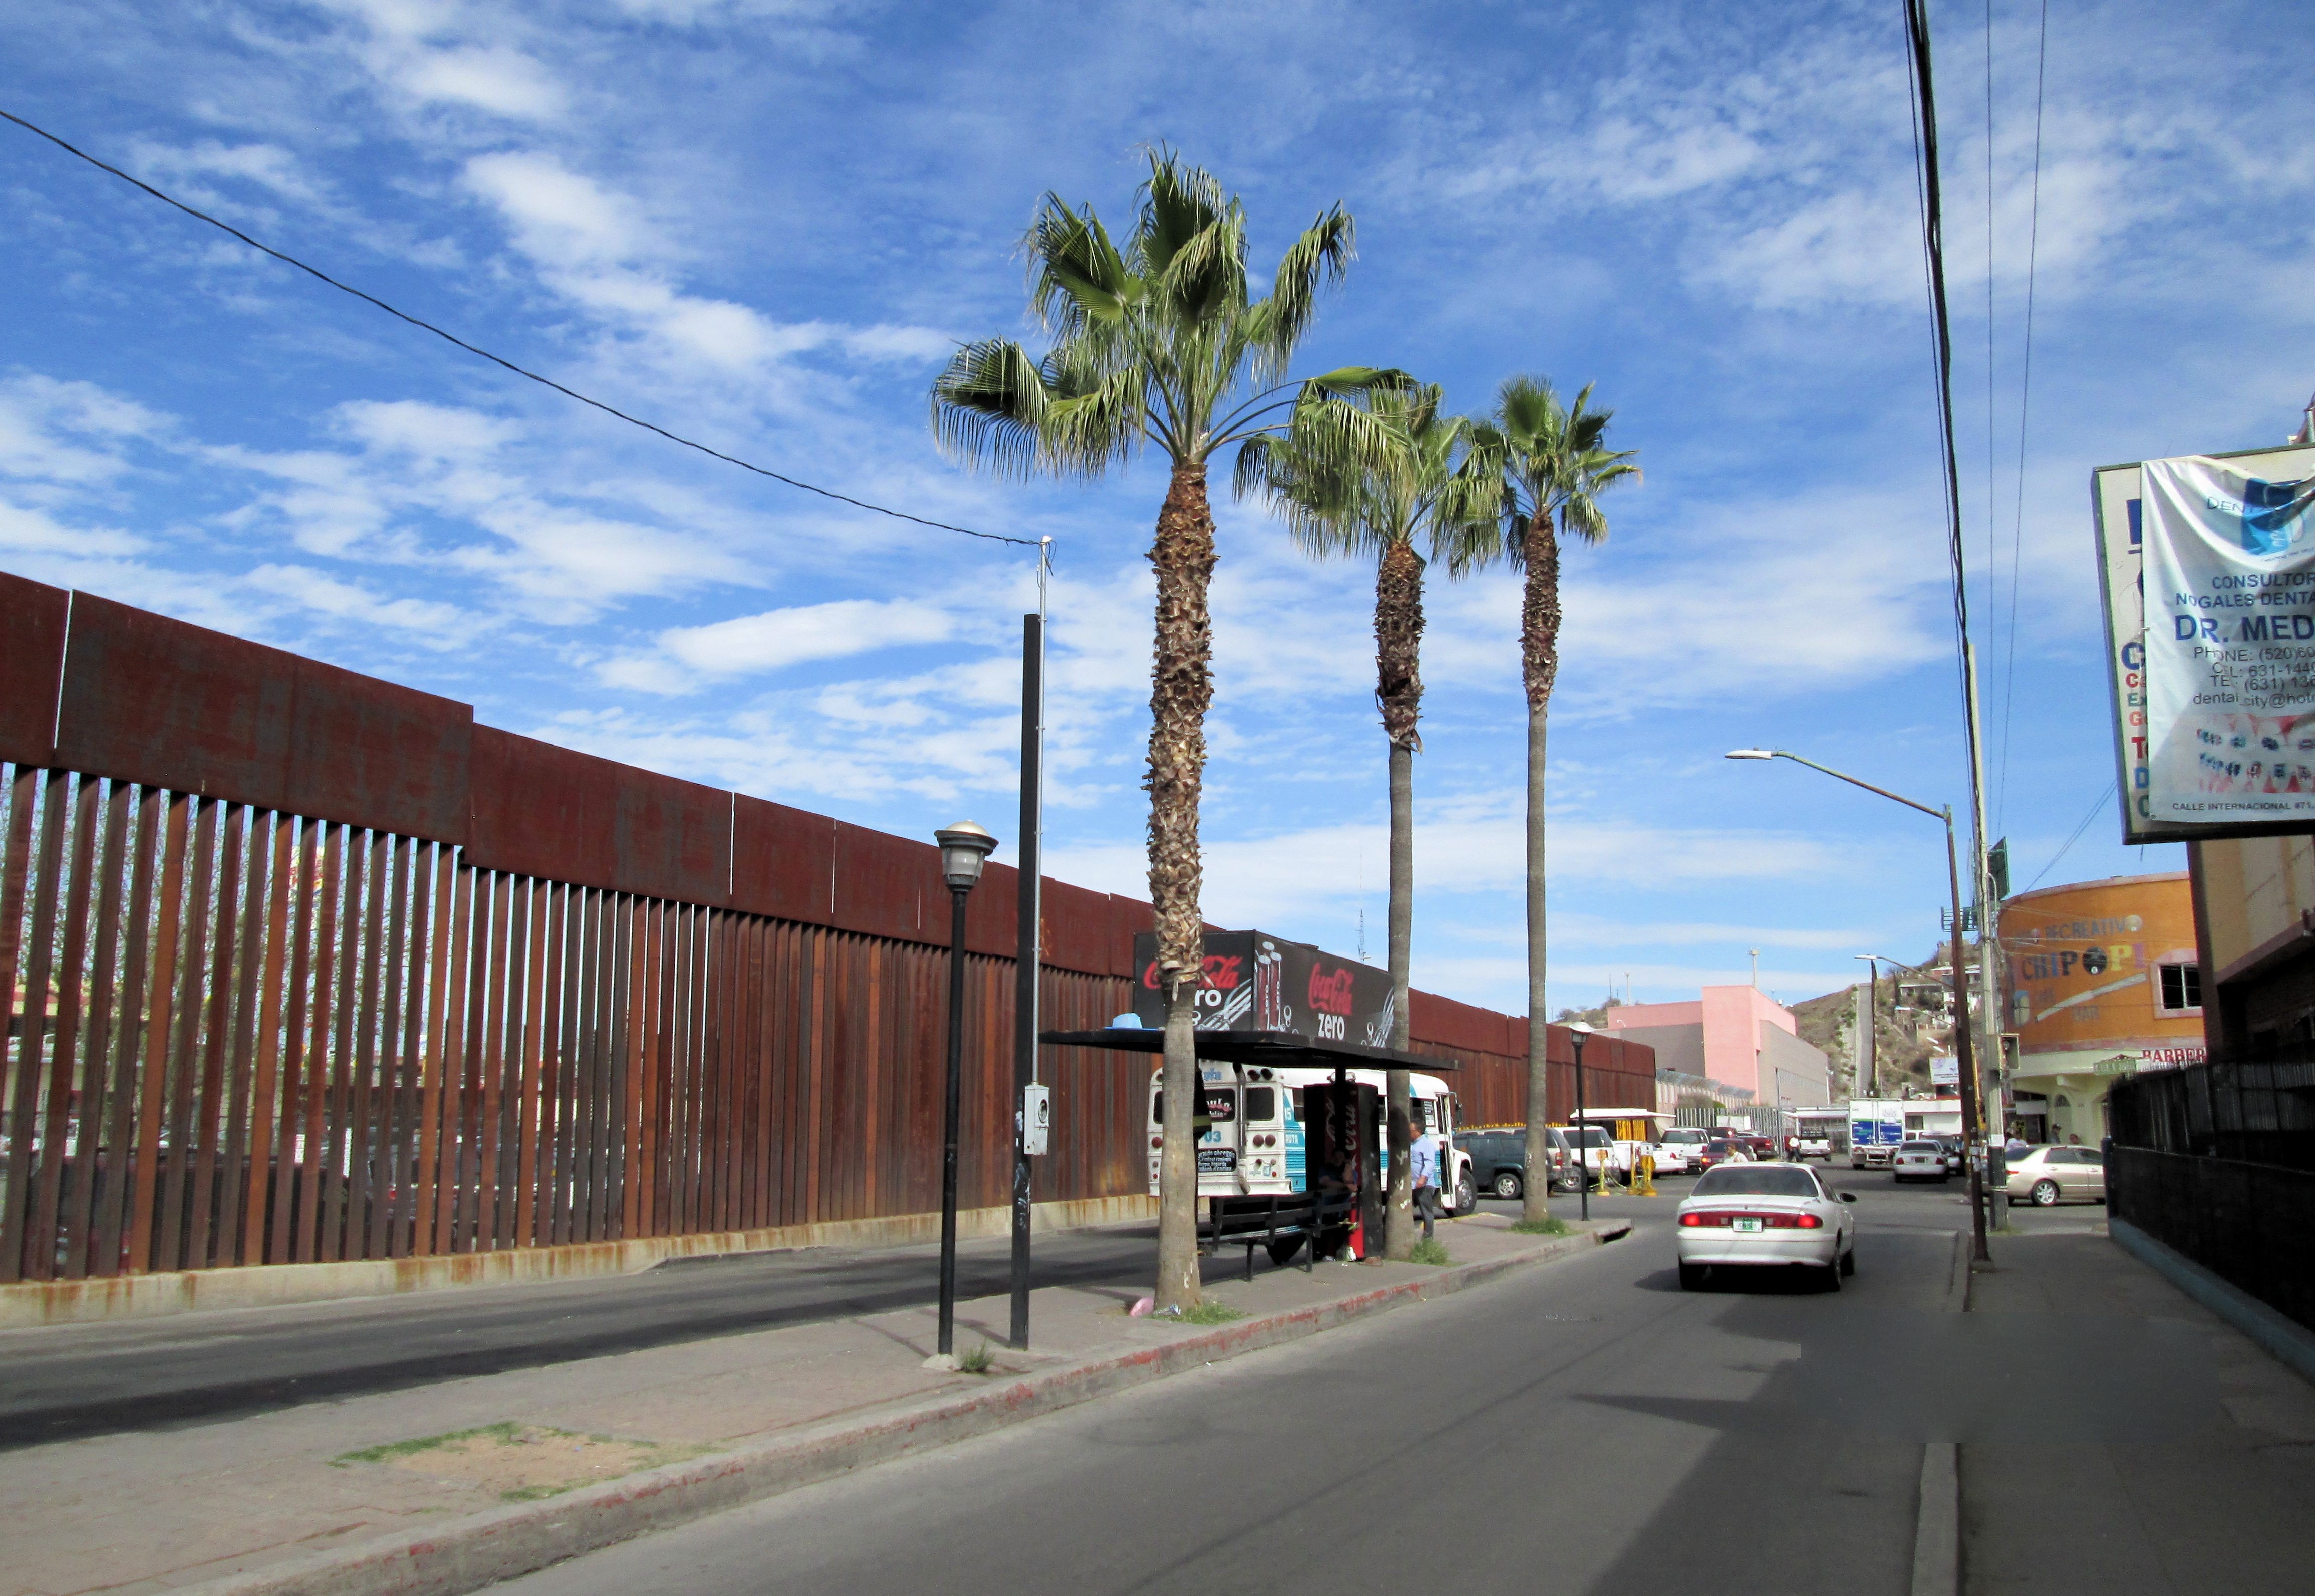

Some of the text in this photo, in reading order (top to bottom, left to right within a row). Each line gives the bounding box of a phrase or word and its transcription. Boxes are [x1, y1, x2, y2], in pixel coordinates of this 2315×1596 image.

[2212, 572, 2315, 589] CONSULTOR
[2176, 593, 2254, 608] NOGALES
[2174, 614, 2315, 643] DR. MED
[2193, 646, 2253, 662] PHONE:
[2208, 802, 2291, 810] INTERNACIONAL
[1318, 1013, 1345, 1041] zero
